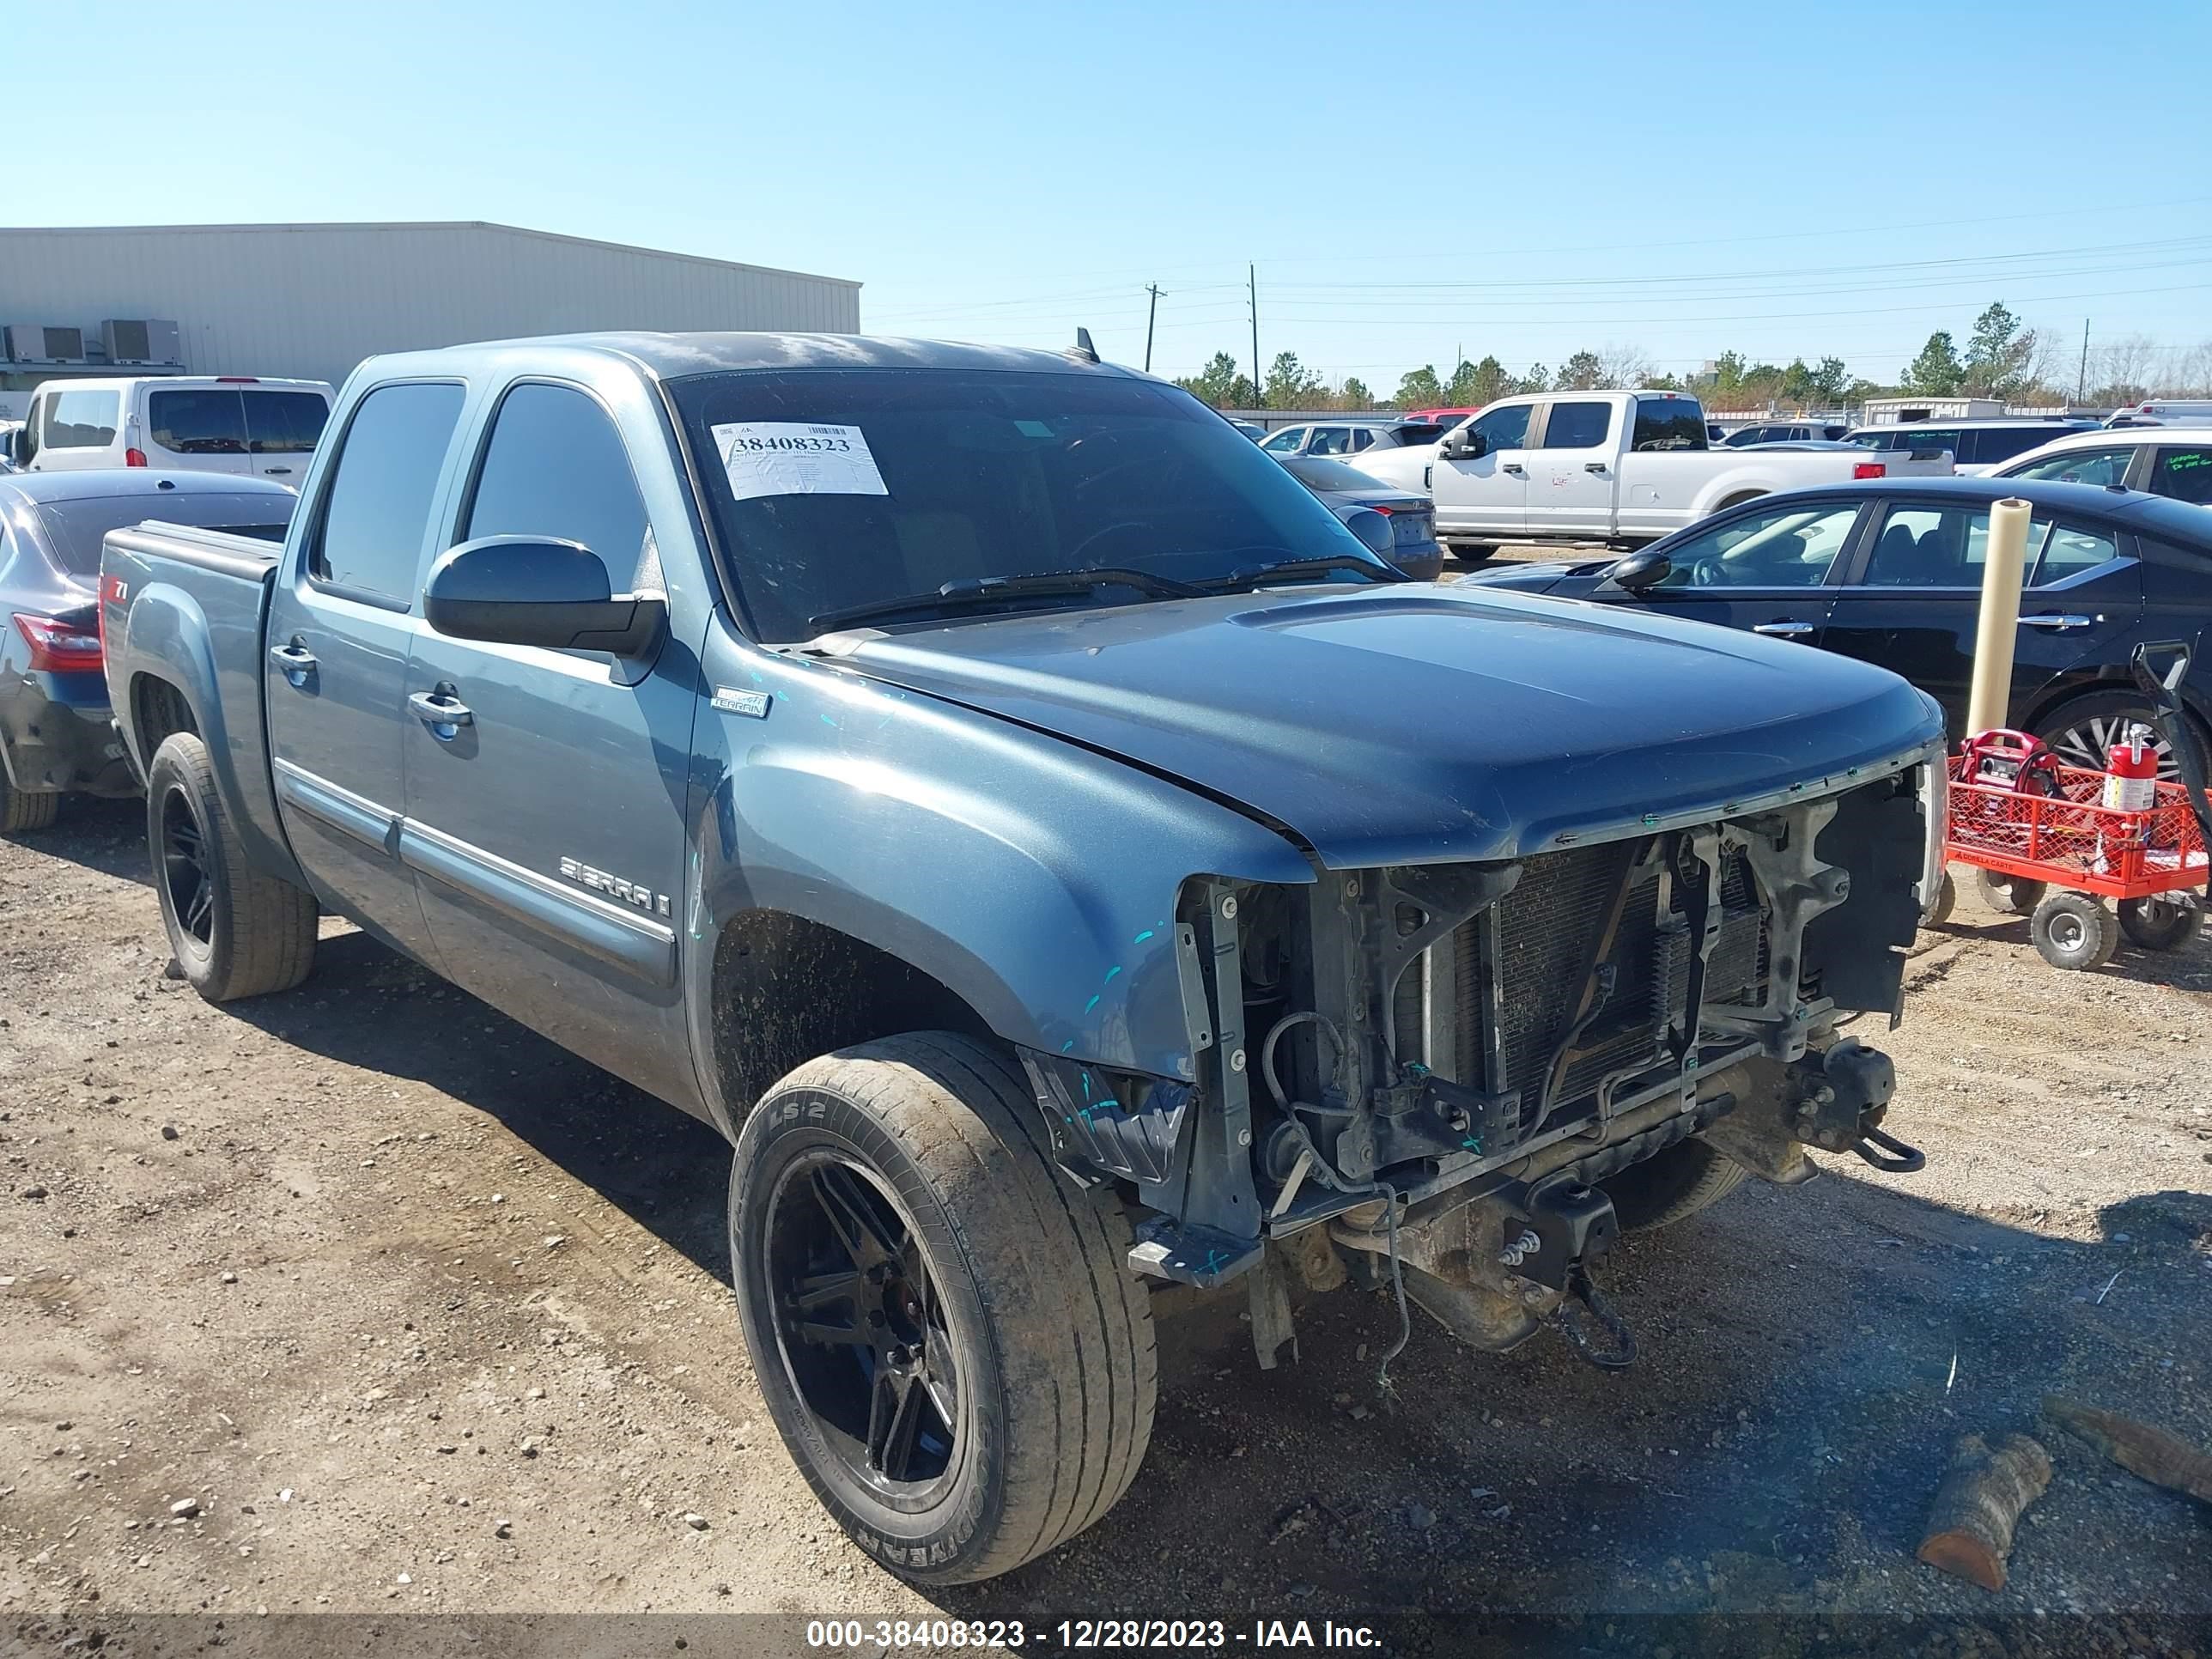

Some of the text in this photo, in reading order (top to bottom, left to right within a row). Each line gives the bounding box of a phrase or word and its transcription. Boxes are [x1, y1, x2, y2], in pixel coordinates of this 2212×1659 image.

[734, 437, 851, 453] 38408323
[715, 698, 763, 714] TERRAIN
[559, 855, 653, 911] SIERRA
